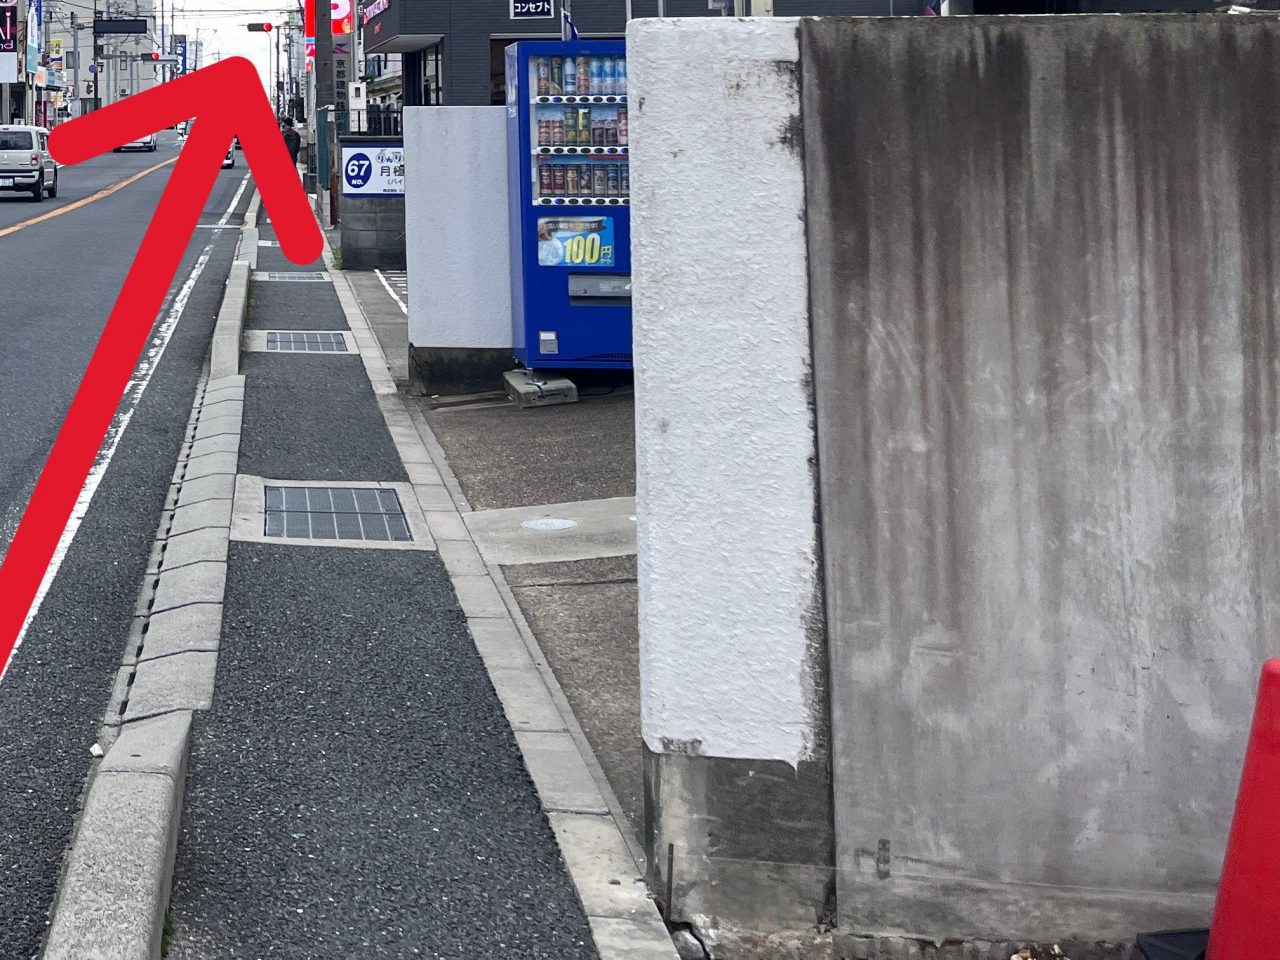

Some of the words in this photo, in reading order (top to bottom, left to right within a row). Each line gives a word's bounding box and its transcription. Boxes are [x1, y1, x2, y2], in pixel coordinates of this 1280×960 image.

[514, 3, 550, 13] コンセプト
[347, 160, 370, 177] 67
